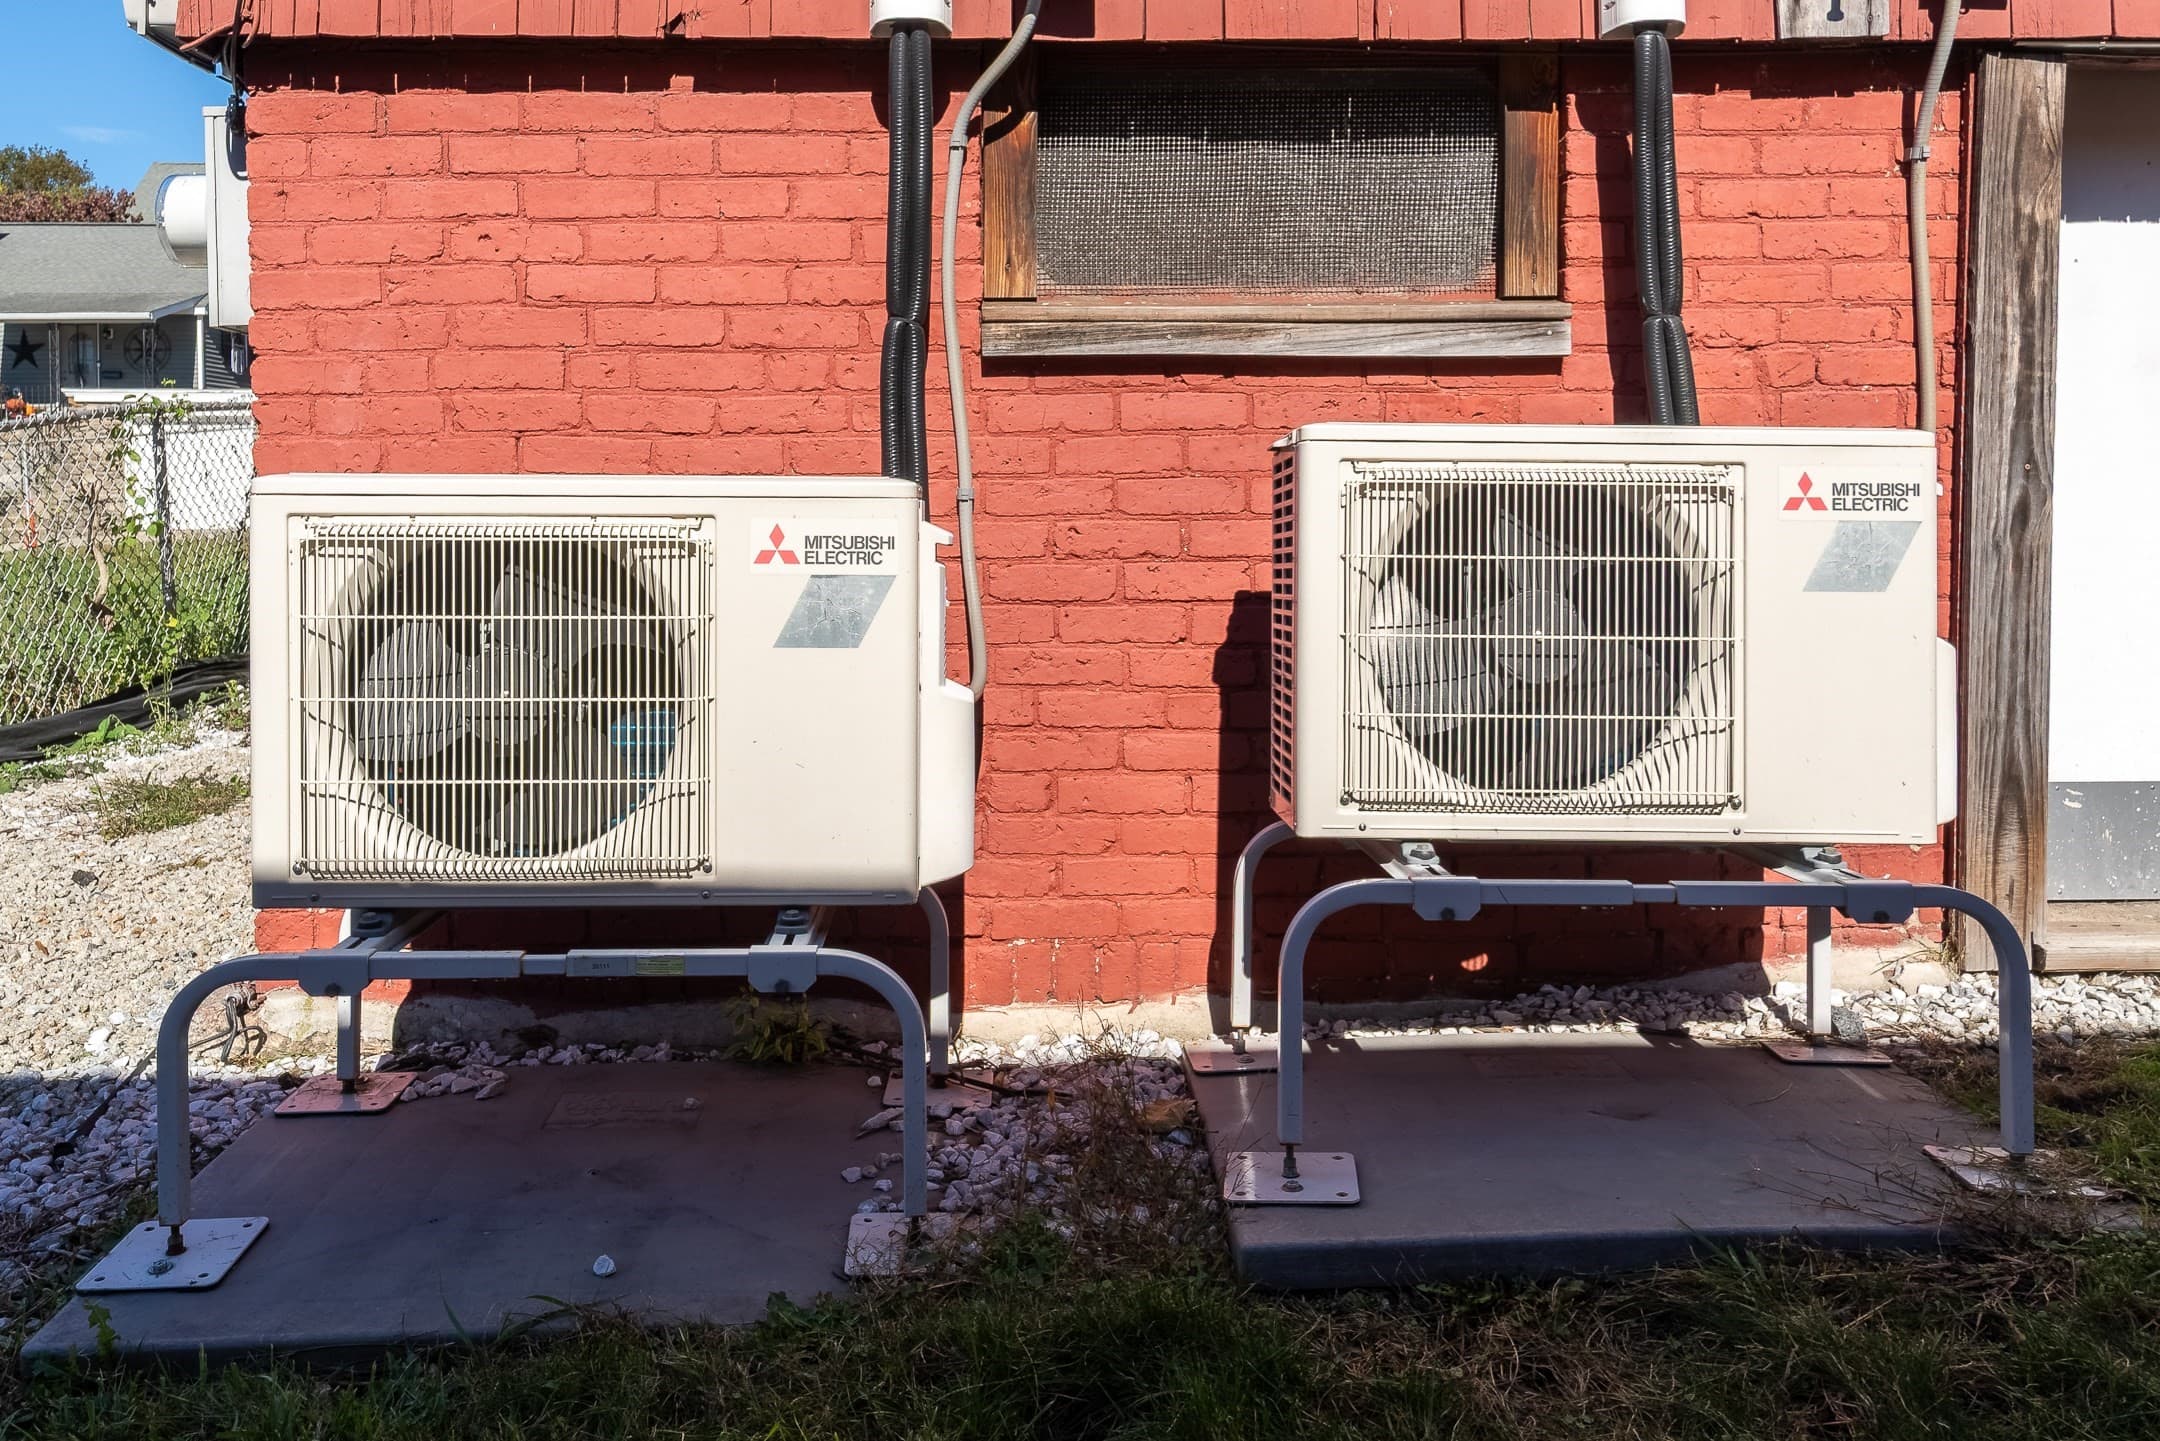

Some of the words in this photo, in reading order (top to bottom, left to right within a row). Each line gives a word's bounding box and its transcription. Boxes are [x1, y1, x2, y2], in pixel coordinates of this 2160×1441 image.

[1832, 483, 1920, 497] MITSUBISHI
[1832, 498, 1908, 511] ELECTRIC
[805, 535, 895, 550] MITSUBISHI
[805, 551, 883, 565] ELECTRIC
